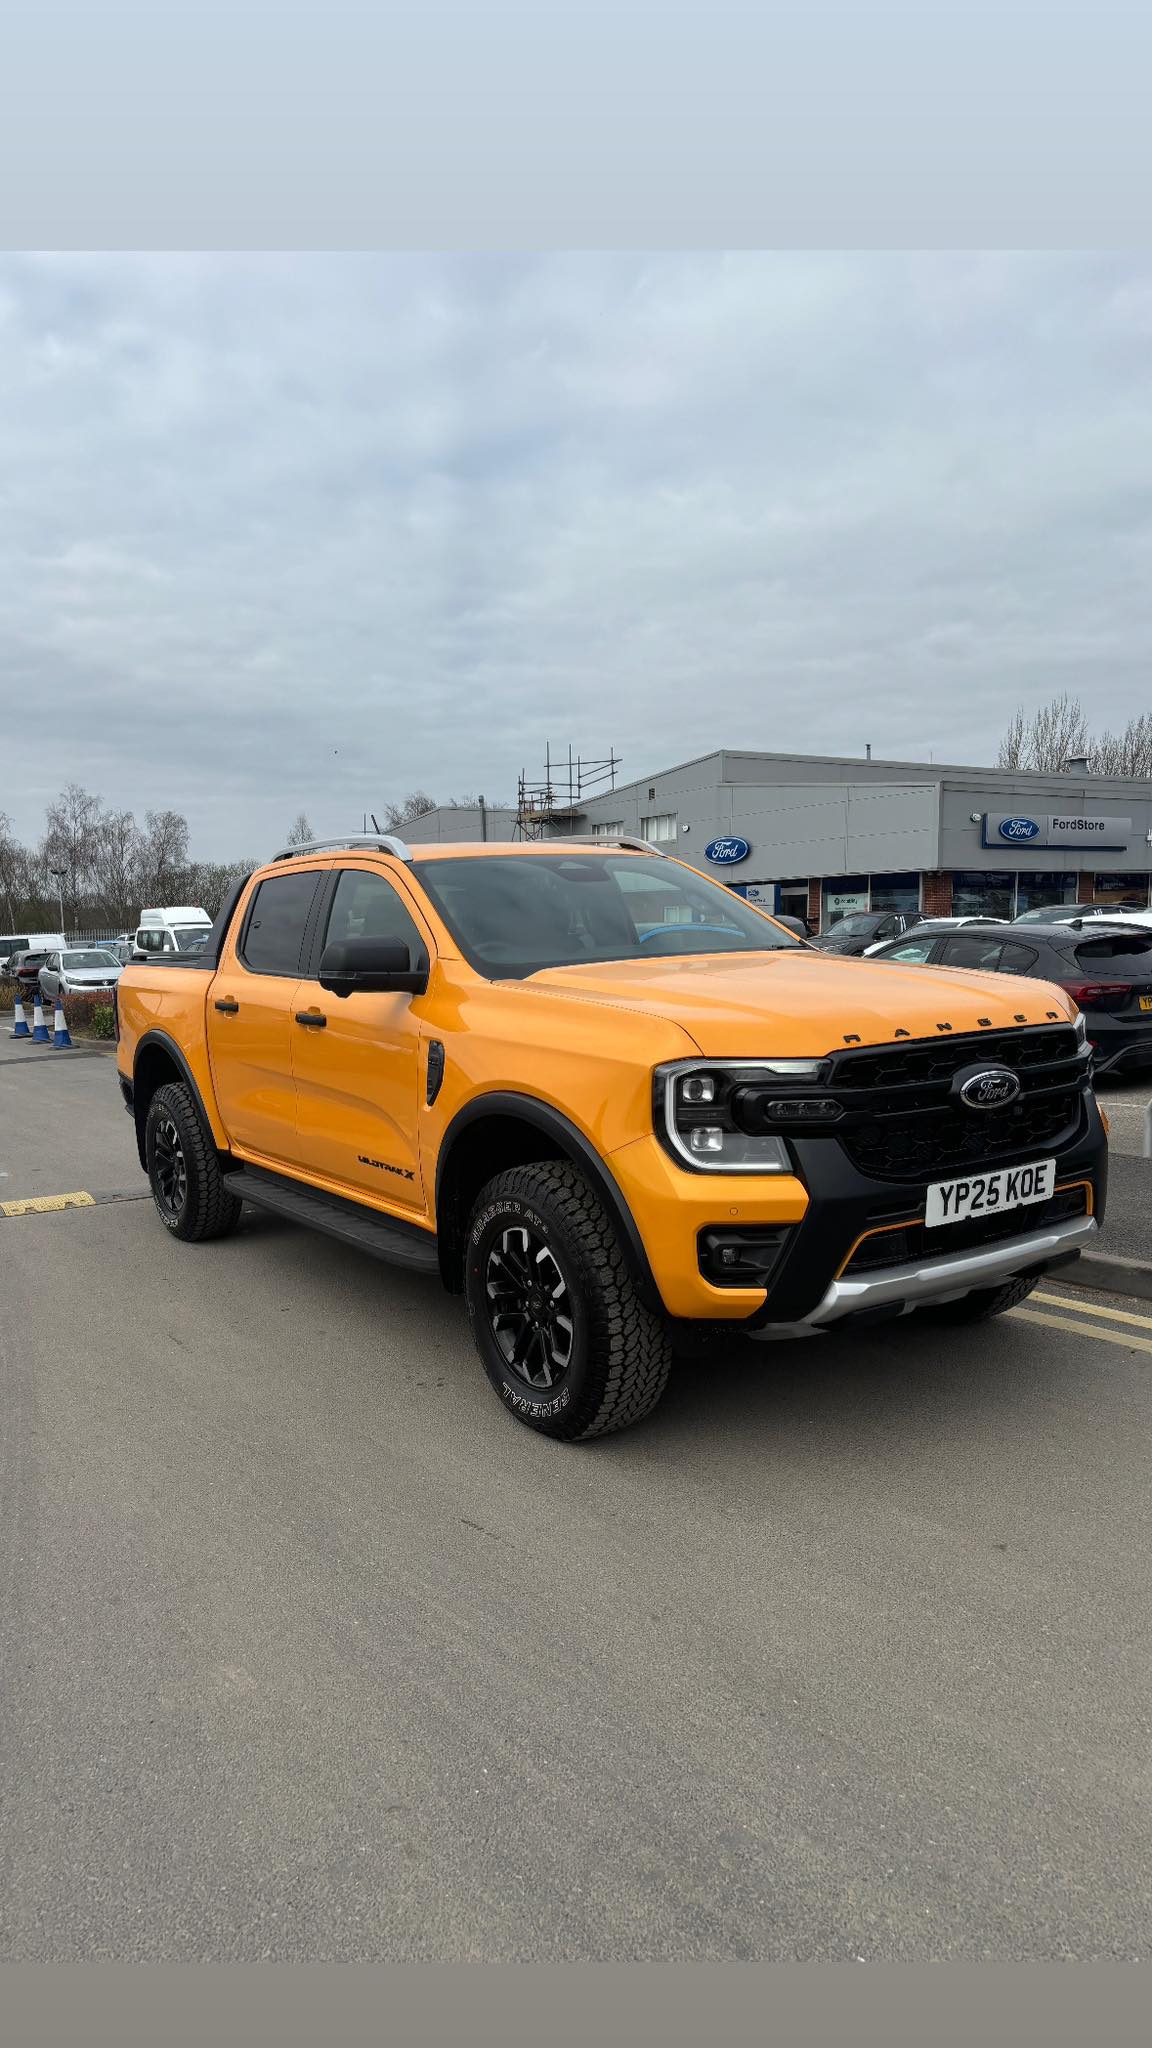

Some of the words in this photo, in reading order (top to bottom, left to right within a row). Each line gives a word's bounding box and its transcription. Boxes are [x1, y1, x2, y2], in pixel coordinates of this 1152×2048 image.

[1052, 818, 1105, 831] FordStore
[711, 841, 739, 859] Ford
[843, 1011, 1059, 1043] RANGER
[977, 1079, 1010, 1101] Ford
[940, 1175, 1001, 1216] YP25
[1006, 1164, 1048, 1202] KOE
[502, 1381, 570, 1418] GENERAL
